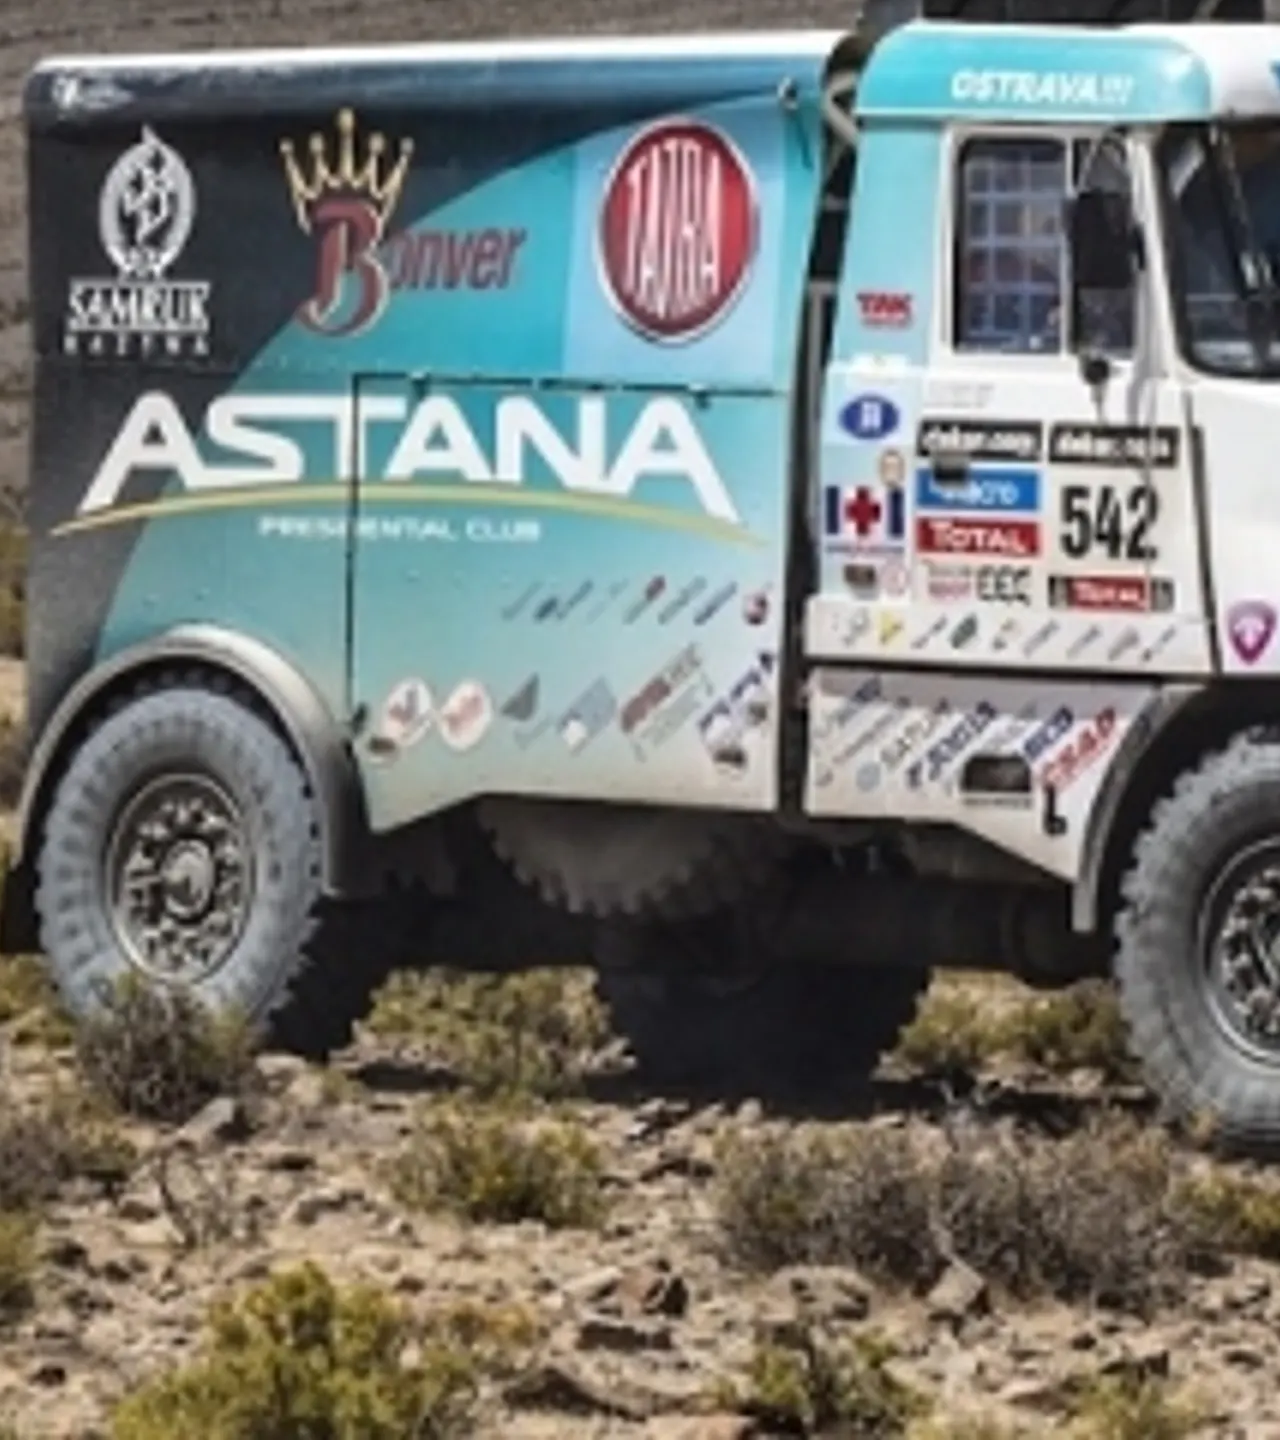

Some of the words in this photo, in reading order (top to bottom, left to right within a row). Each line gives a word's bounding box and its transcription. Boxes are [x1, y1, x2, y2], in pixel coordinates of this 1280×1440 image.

[295, 197, 528, 339] Bonver
[627, 138, 720, 320] TATRA
[78, 391, 742, 522] ASTANA
[929, 521, 1026, 552] TOTAL
[1061, 485, 1159, 560] 542
